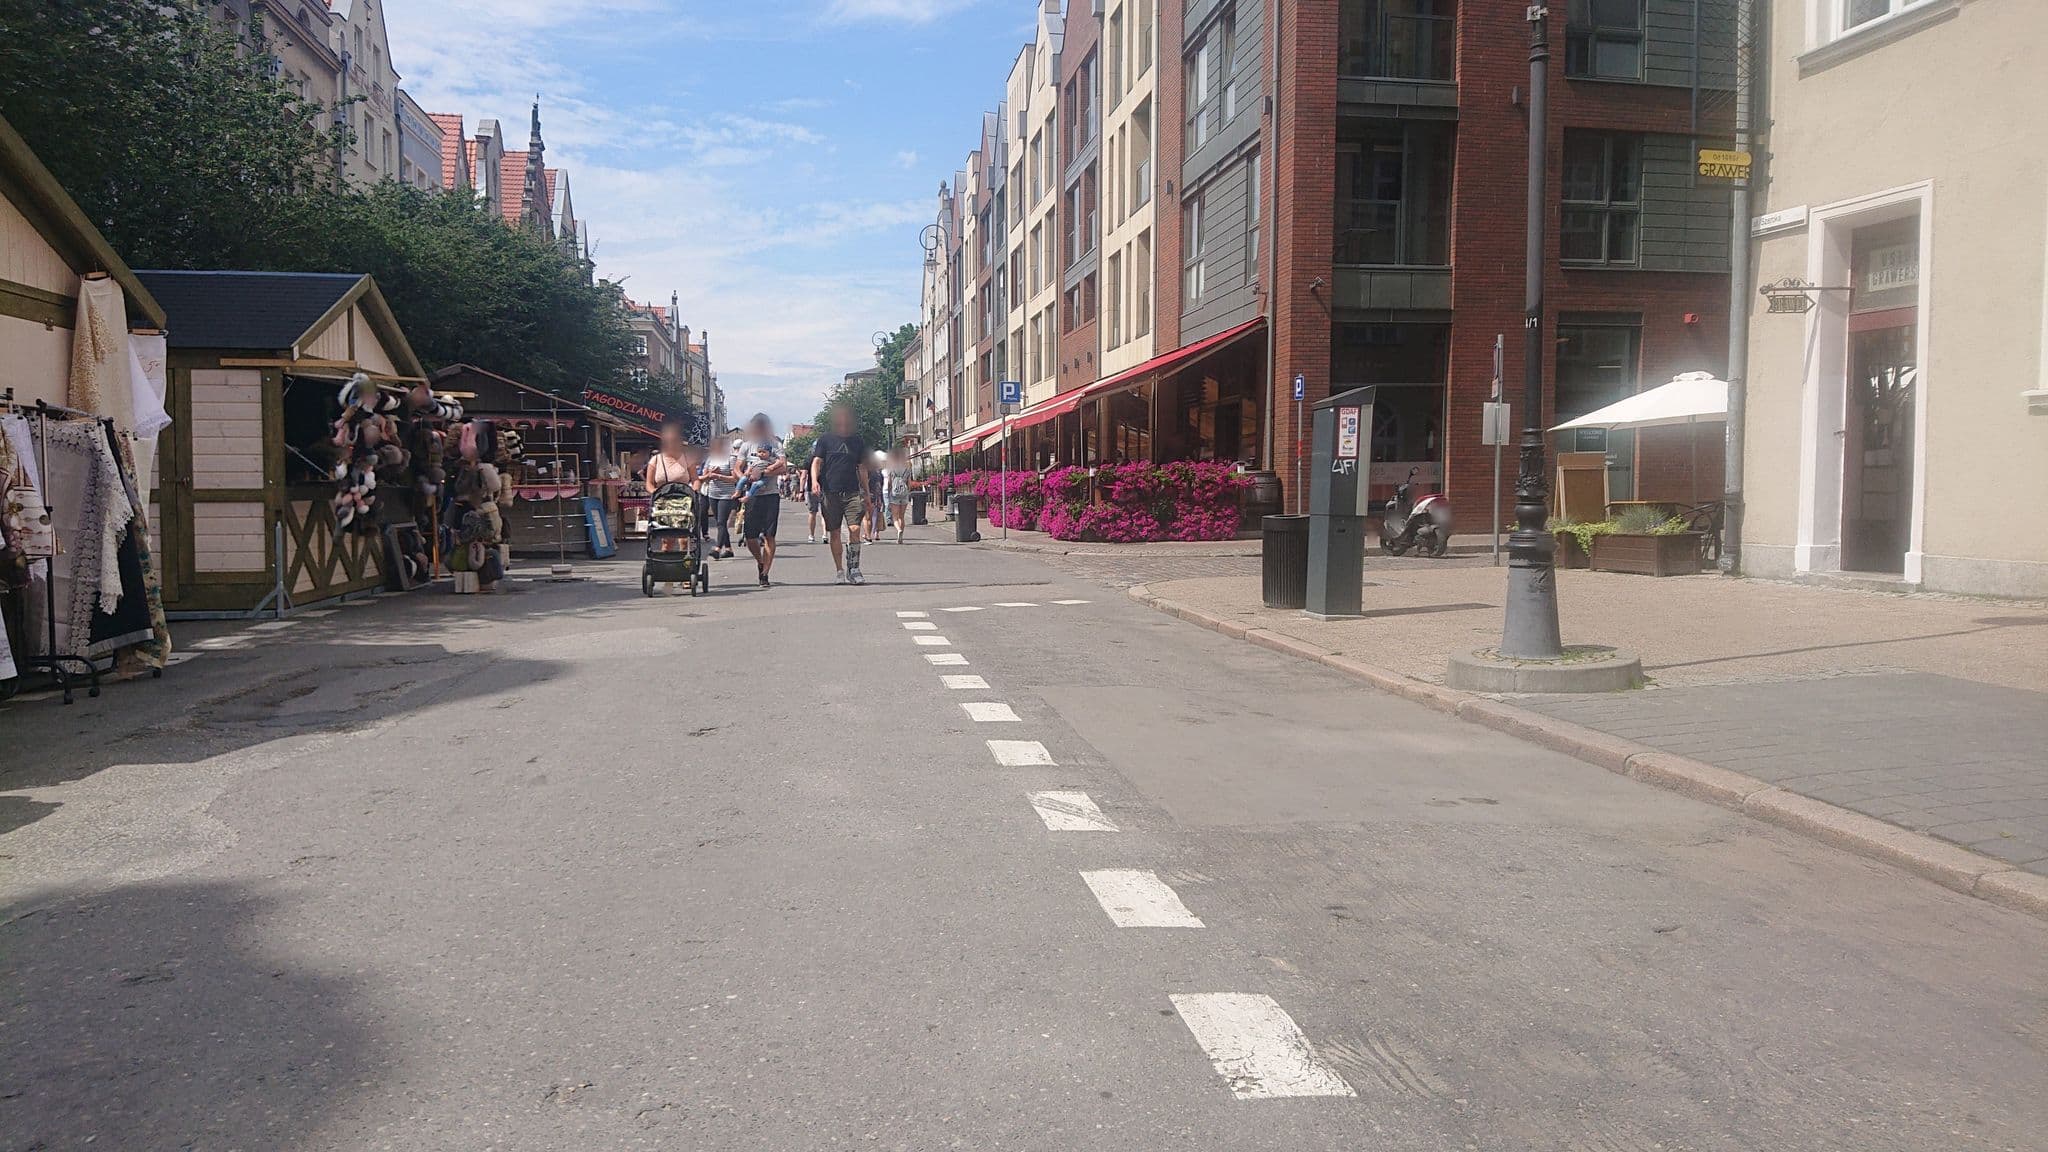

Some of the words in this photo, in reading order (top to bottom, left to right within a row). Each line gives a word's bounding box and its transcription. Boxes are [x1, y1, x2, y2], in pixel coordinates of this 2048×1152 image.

[1003, 383, 1015, 400] P
[1295, 378, 1302, 396] P
[585, 389, 666, 422] JAGODZIANKI
